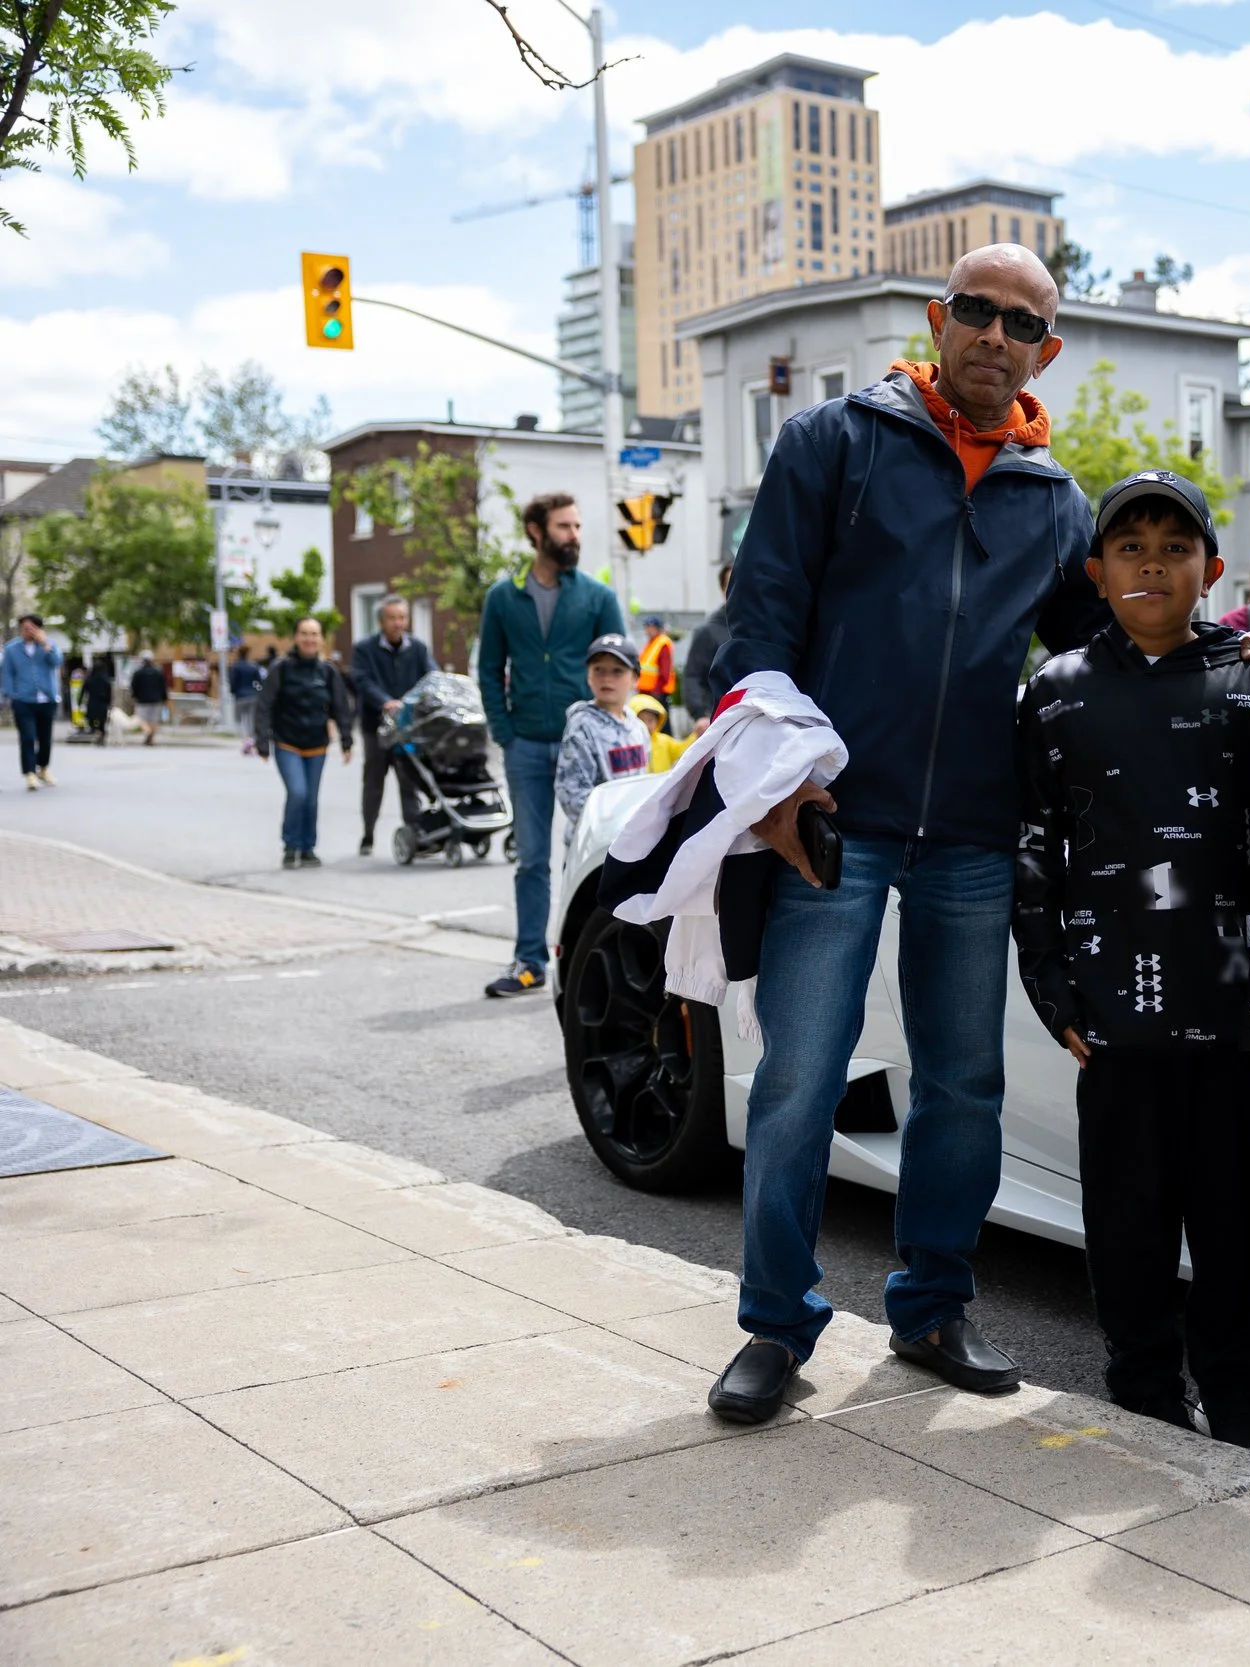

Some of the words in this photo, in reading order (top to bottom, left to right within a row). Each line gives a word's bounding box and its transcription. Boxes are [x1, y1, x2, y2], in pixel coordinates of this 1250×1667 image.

[1153, 826, 1185, 834] UNDER
[1163, 832, 1203, 840] ARMOUR
[1090, 869, 1116, 877] ARMOUR
